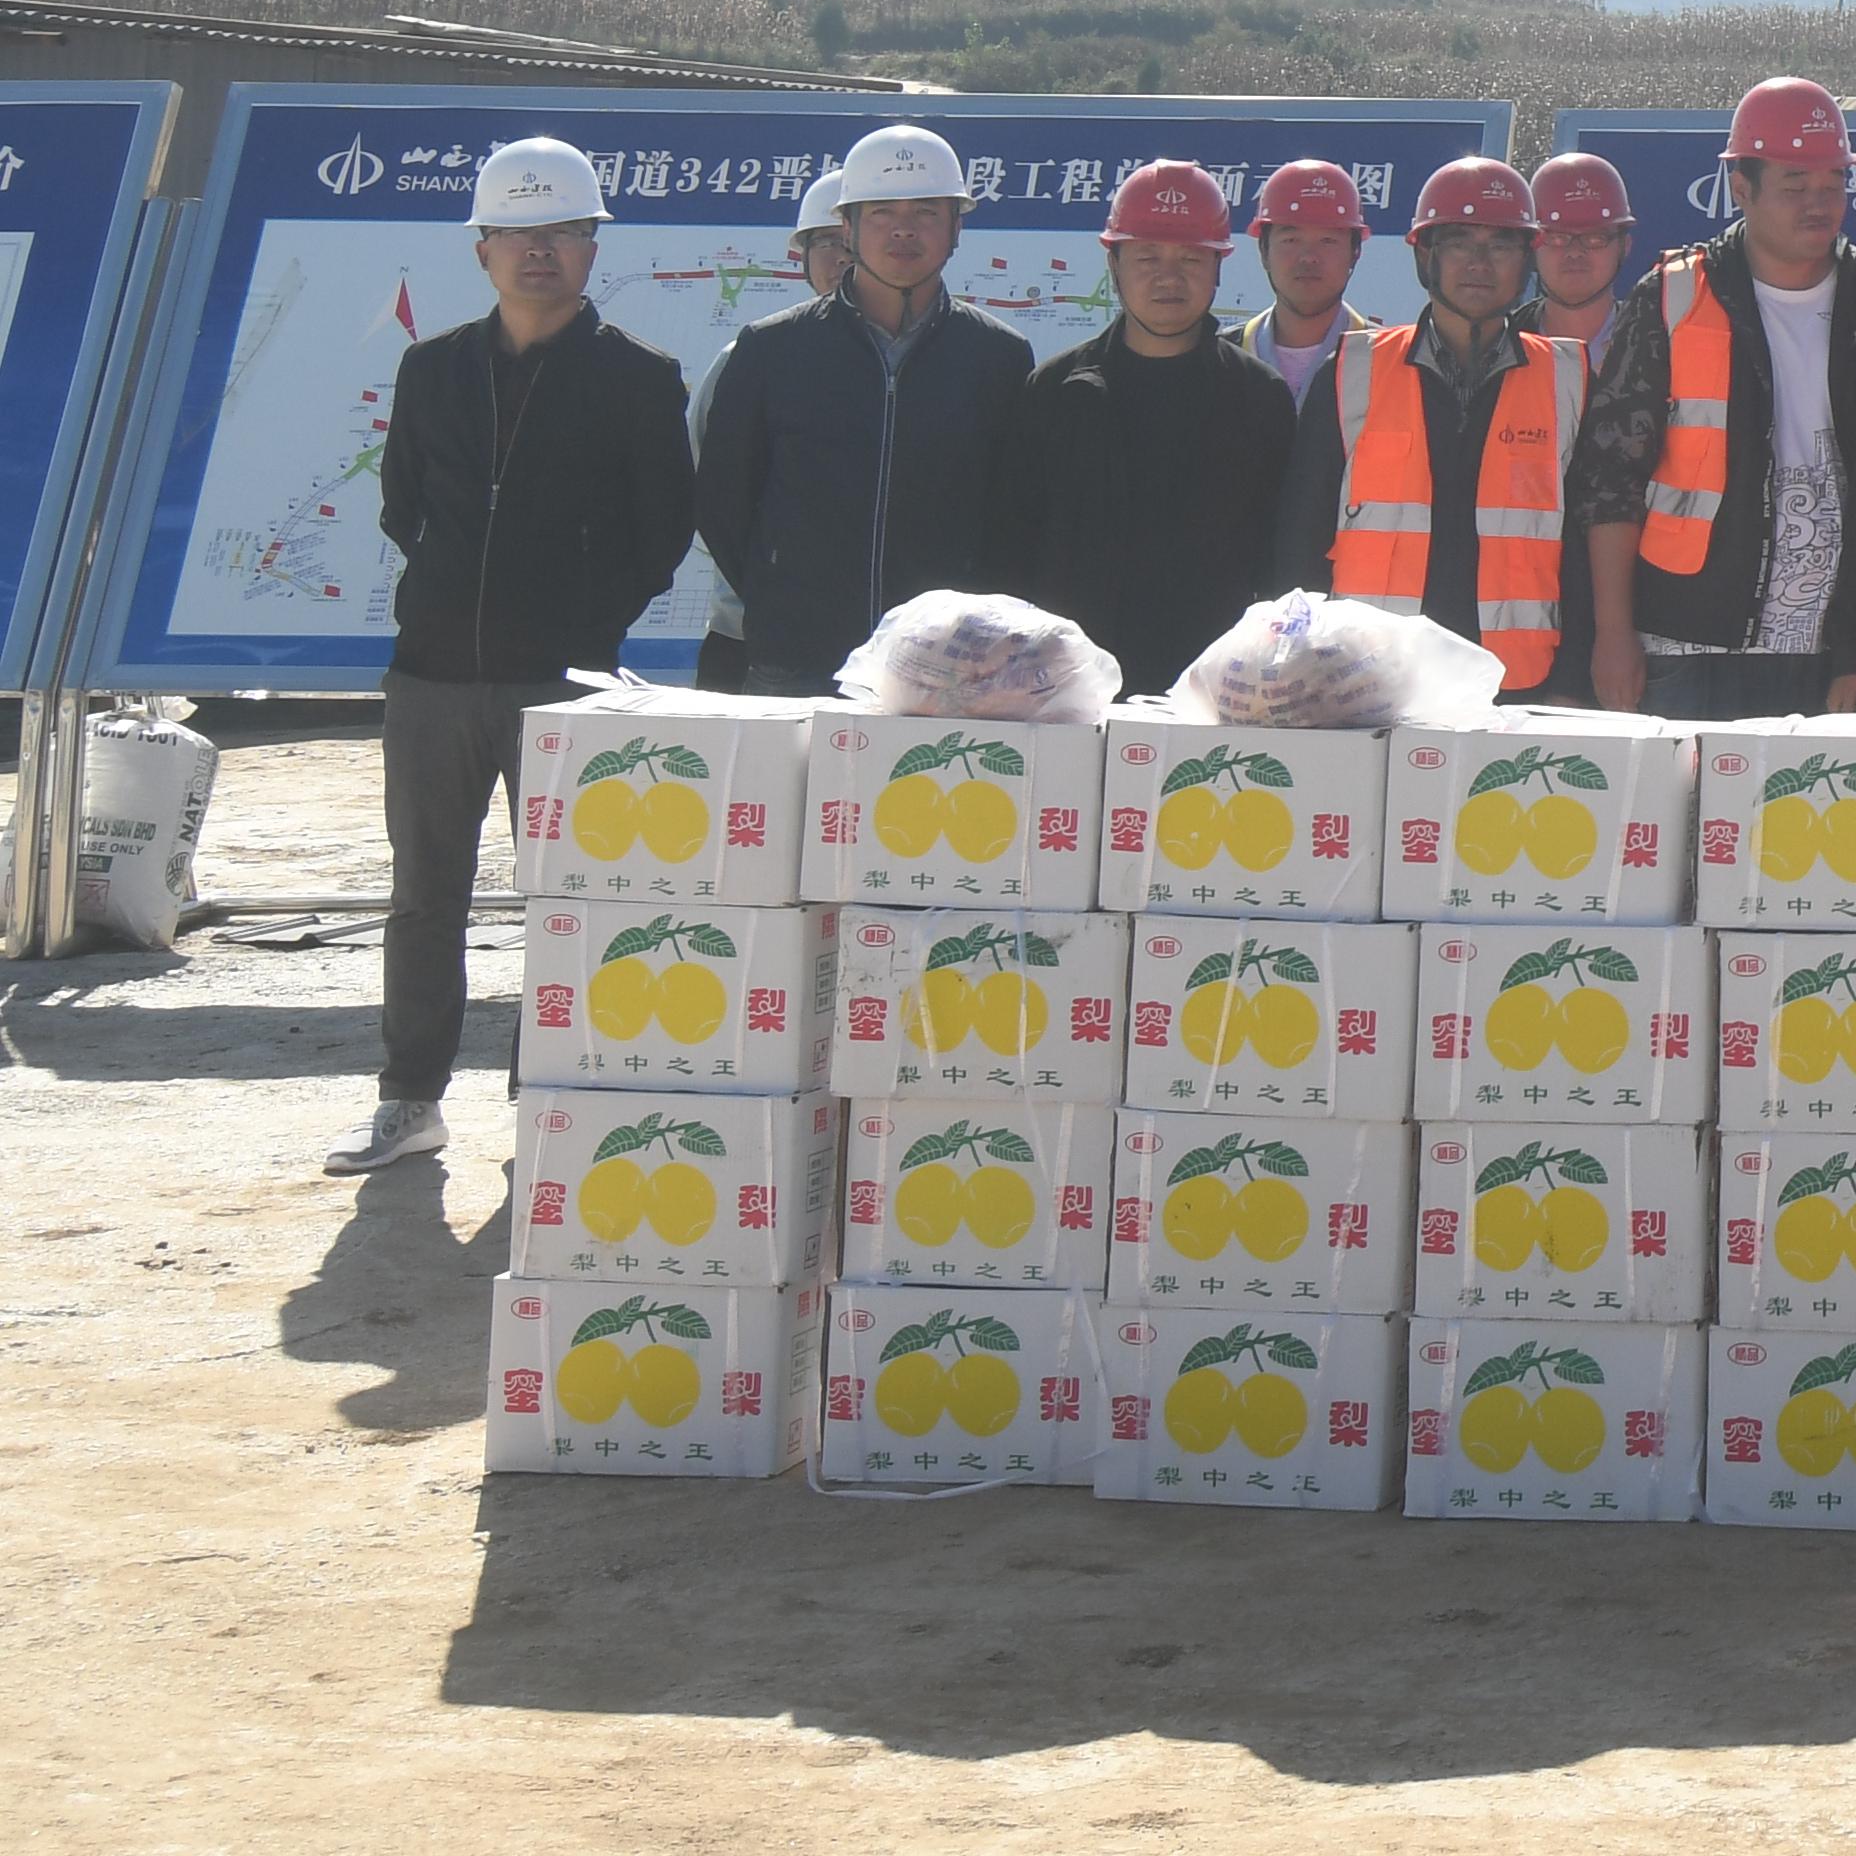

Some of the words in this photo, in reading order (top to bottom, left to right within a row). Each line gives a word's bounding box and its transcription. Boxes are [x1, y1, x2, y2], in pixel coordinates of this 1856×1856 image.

[595, 149, 1394, 209] 国道342晋段工程面图
[729, 803, 765, 847] 梨
[1040, 807, 1078, 851] 梨
[1111, 807, 1148, 852] 蜜
[1313, 814, 1350, 859] 梨
[1403, 819, 1441, 864] 蜜
[1704, 819, 1740, 865] 蜜
[110, 843, 145, 856] ONLY
[562, 873, 715, 896] 梨中之王
[537, 984, 575, 1028] 蜜
[749, 988, 786, 1032] 梨
[850, 996, 887, 1041] 蜜
[1071, 998, 1112, 1042] 梨
[1339, 1008, 1377, 1055] 梨
[897, 1066, 1063, 1088] 梨中之王
[1475, 1082, 1643, 1108] 梨中之王
[1423, 1212, 1458, 1254] 蜜
[572, 1252, 730, 1277] 梨中之王
[504, 1369, 544, 1414] 蜜
[556, 1439, 713, 1461] 梨中之王
[866, 1452, 1034, 1471] 梨中之王
[1450, 1489, 1618, 1510] 梨中之王
